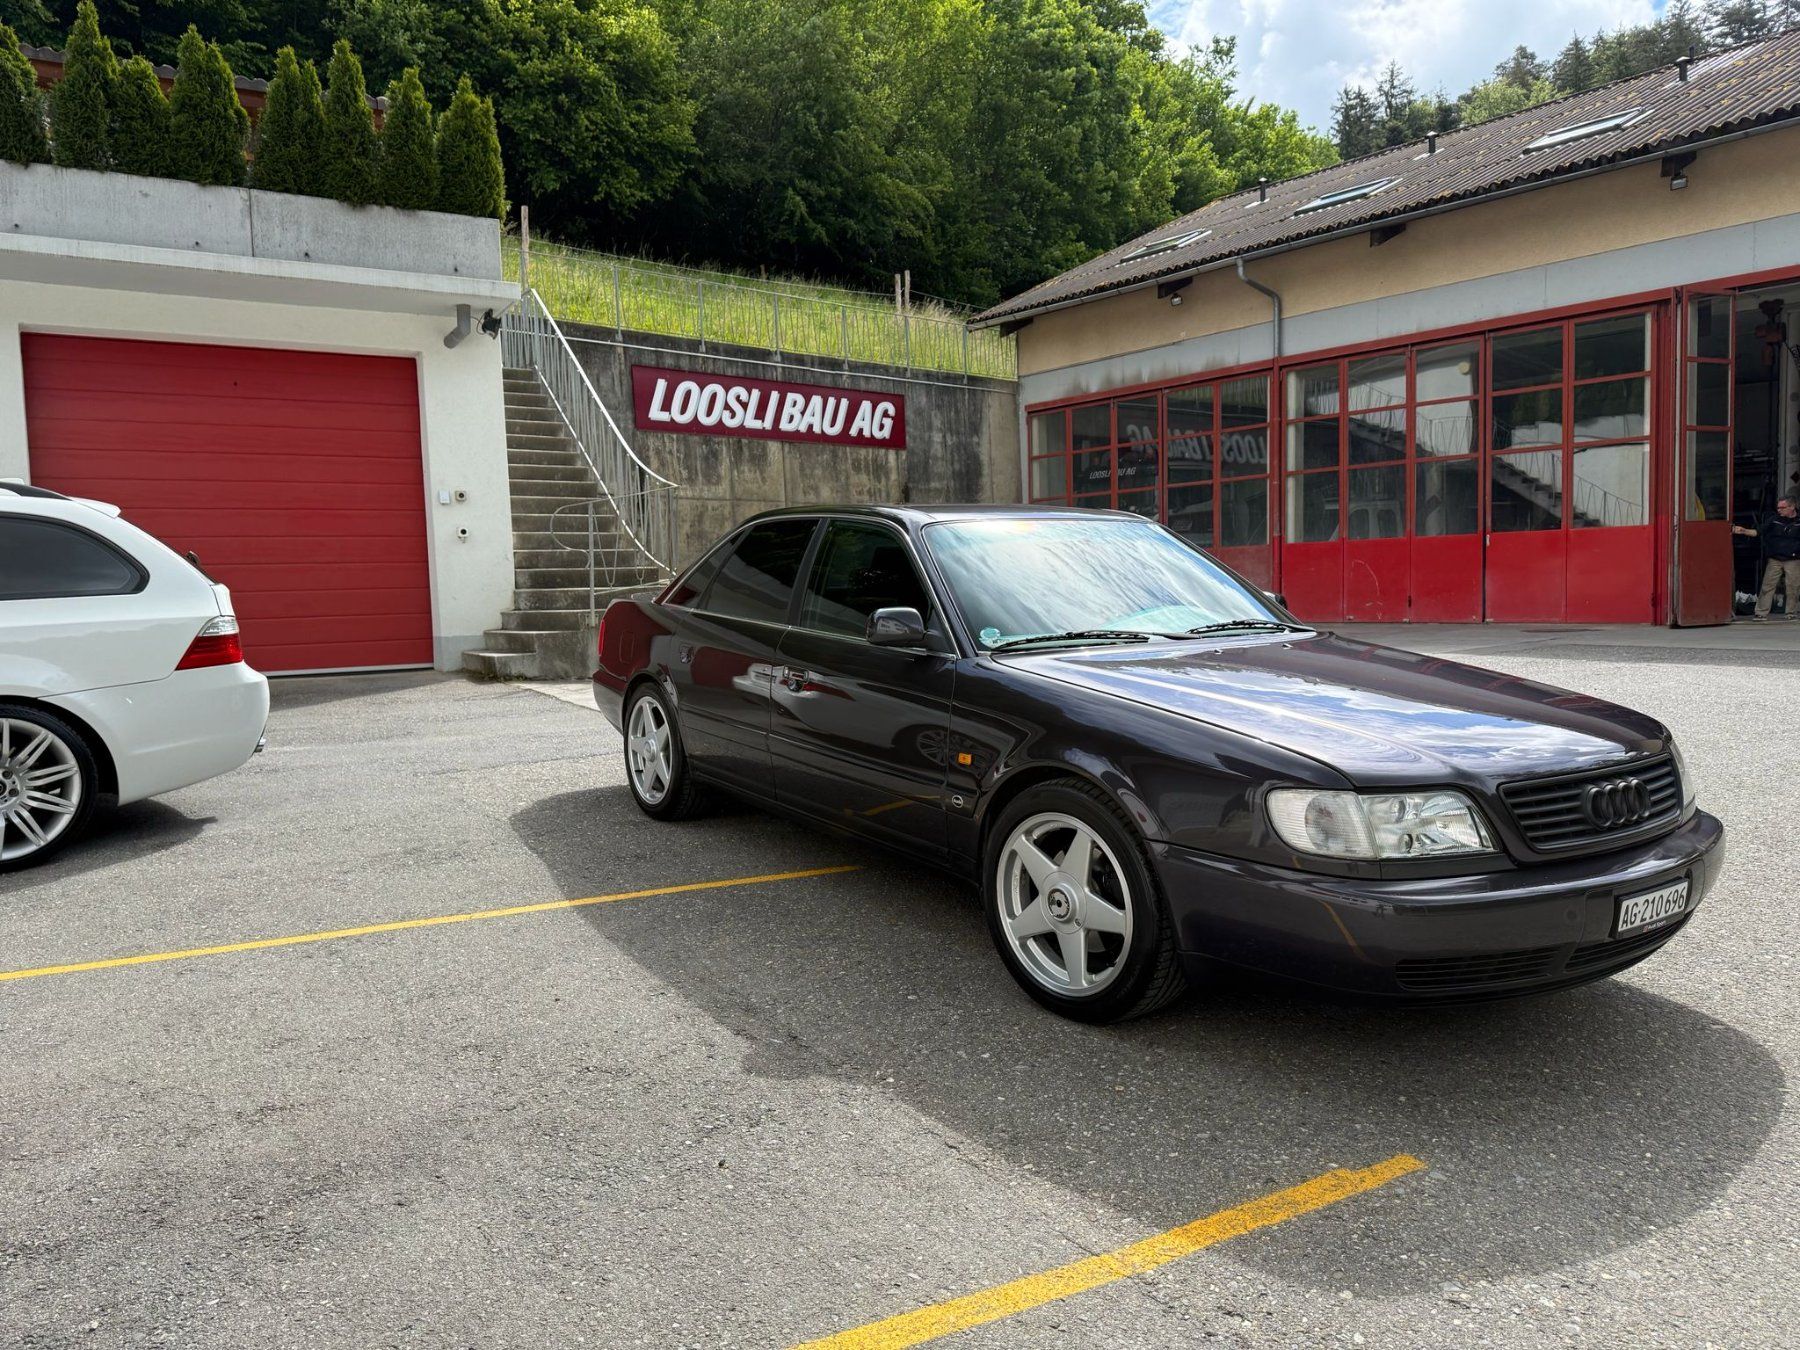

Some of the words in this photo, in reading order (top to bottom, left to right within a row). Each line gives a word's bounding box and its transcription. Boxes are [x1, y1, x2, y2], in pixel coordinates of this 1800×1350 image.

[648, 378, 779, 430] LOOSLI
[779, 392, 849, 436] BAU
[849, 400, 895, 439] AG
[1125, 466, 1137, 475] AG
